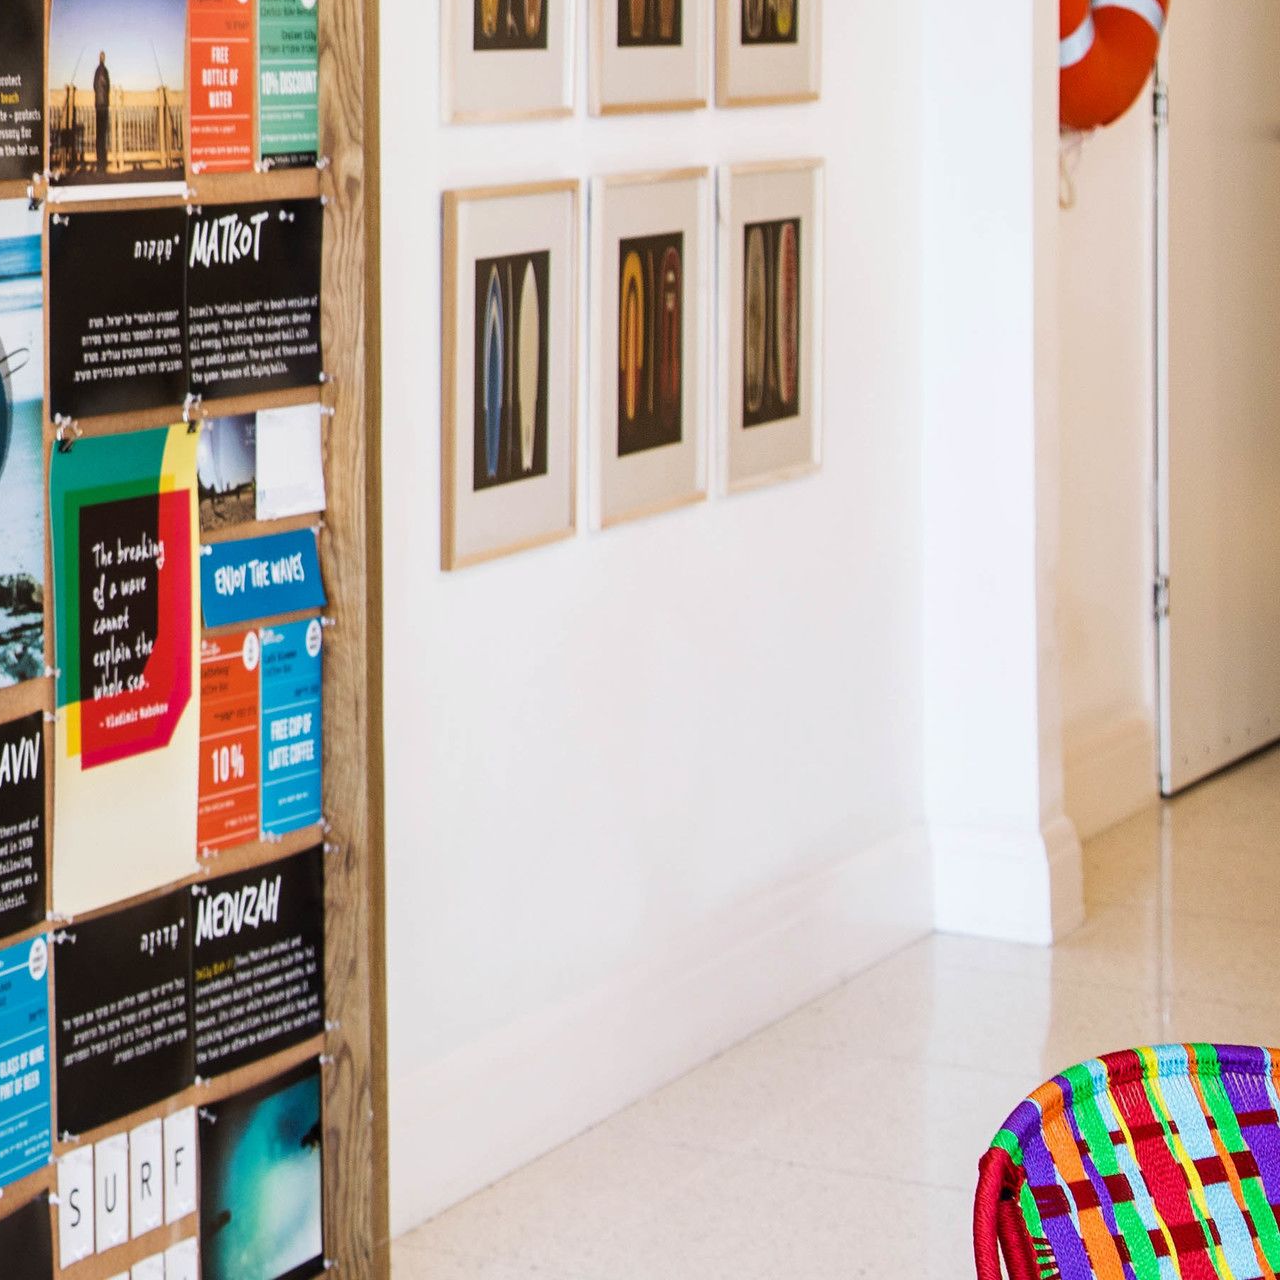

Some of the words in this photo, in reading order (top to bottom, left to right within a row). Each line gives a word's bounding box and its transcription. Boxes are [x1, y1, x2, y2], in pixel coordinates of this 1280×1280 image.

[210, 45, 230, 65] FREE
[201, 67, 228, 87] BOTTLE
[208, 90, 234, 109] WATER
[189, 210, 270, 268] MATKOT
[92, 541, 113, 569] The
[116, 531, 166, 571] breaking
[92, 572, 106, 611] of
[109, 581, 118, 599] a
[120, 576, 147, 597] wave
[214, 564, 247, 597] ENJOY
[247, 558, 270, 588] THE
[269, 552, 306, 585] WAVES
[92, 605, 129, 636] cannot
[92, 634, 132, 680] explain
[134, 631, 154, 659] the
[92, 666, 124, 702] whole
[126, 673, 151, 694] sea.
[270, 717, 288, 742] FREE
[211, 742, 245, 785] 10%
[288, 738, 315, 766] COFFEE
[195, 874, 282, 948] MEDUZAH
[0, 1055, 20, 1079] GLASS
[19, 1051, 29, 1072] OF
[29, 1044, 46, 1067] WINE
[14, 1076, 23, 1096] OF
[23, 1068, 41, 1093] BEER
